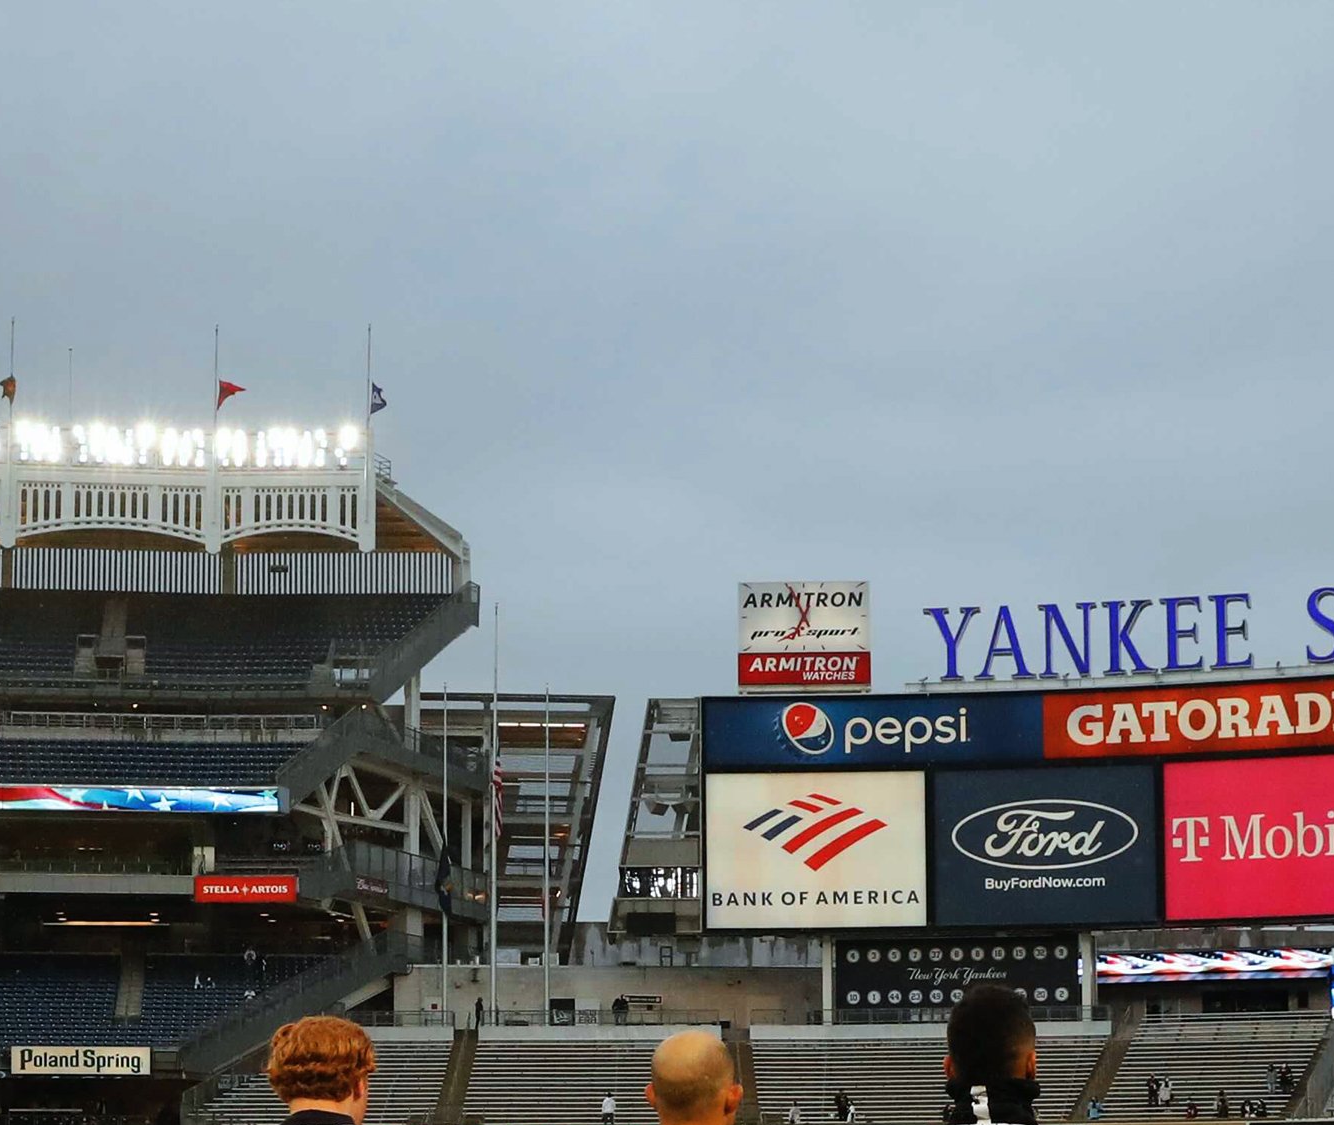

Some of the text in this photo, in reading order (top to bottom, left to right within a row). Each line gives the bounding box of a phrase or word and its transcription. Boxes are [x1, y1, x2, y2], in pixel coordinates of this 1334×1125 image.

[743, 592, 863, 609] ARMITRON
[751, 627, 860, 641] pro sport
[924, 592, 1253, 681] YANKEE
[749, 656, 857, 672] ARMITRON
[803, 671, 855, 681] WATCHES
[844, 708, 968, 753] pepsi
[992, 809, 1105, 858] Ford
[203, 885, 288, 894] STELLA ARTOIS
[984, 875, 1106, 891] BuyFordNow.com
[712, 889, 920, 907] BANK OF AMERICA
[907, 967, 1007, 985] New York Yankees
[20, 1048, 141, 1073] Poland Spring
